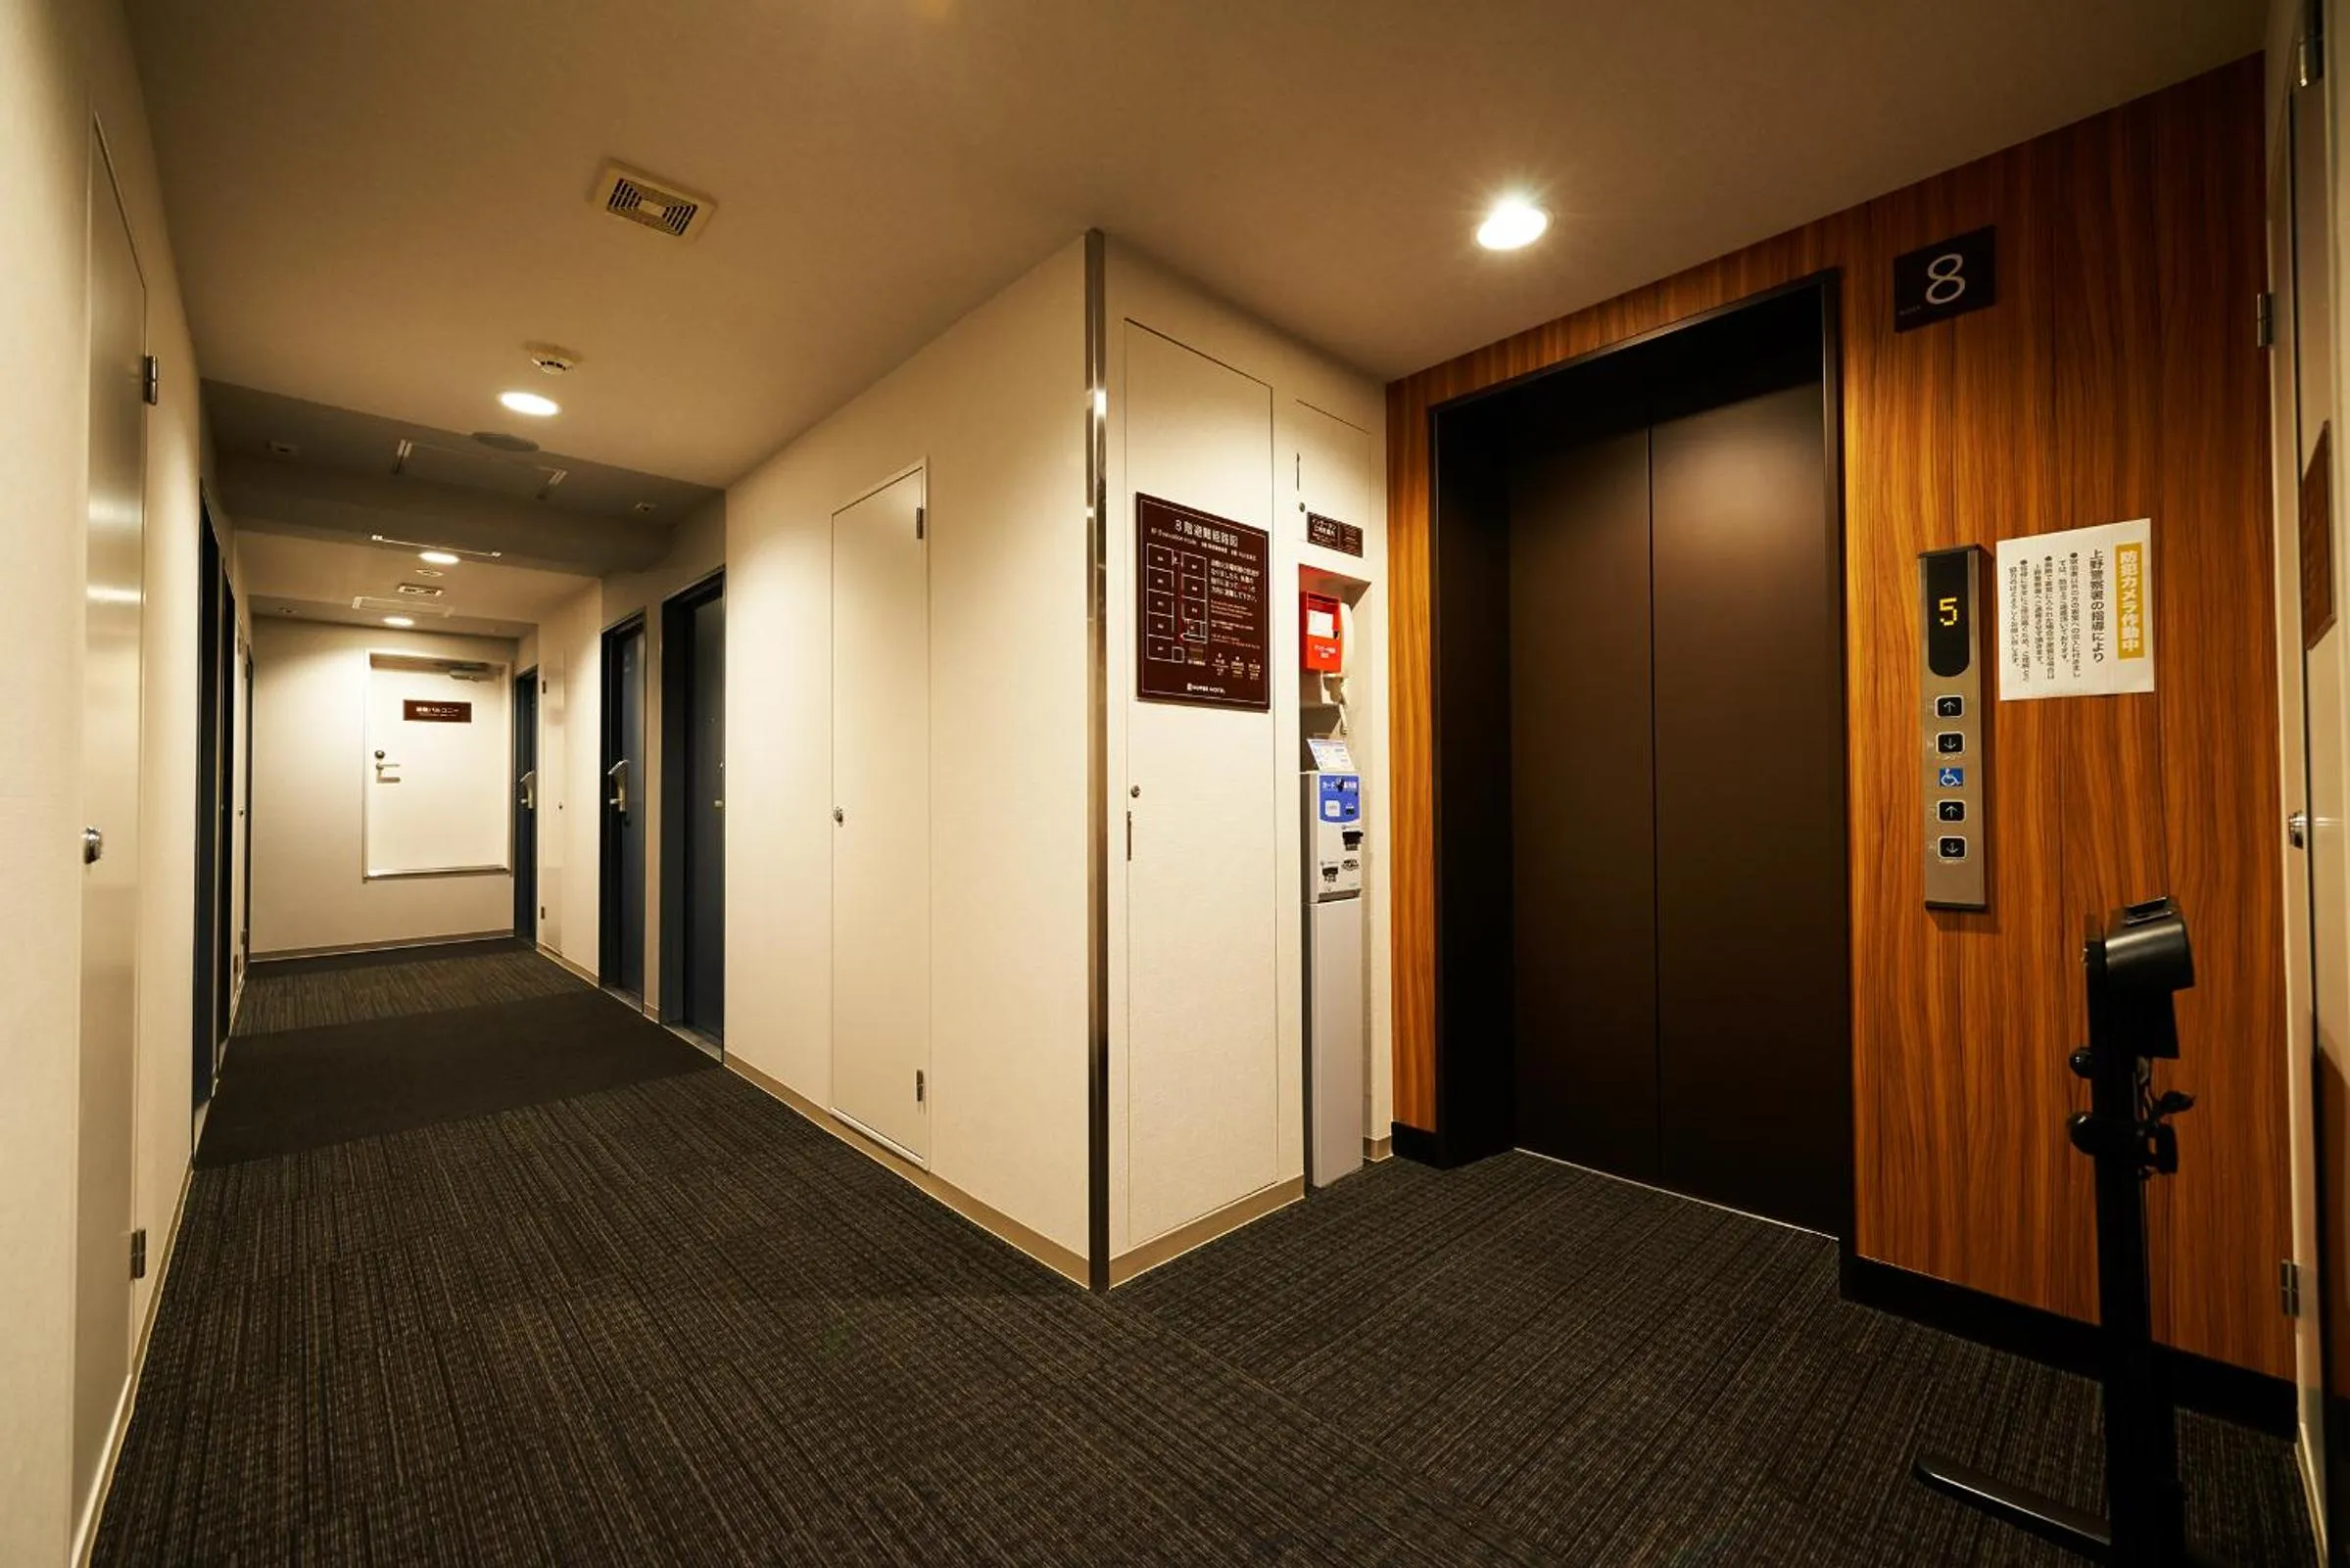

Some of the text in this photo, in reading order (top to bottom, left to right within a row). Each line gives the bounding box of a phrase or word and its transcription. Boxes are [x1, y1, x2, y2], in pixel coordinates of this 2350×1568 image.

[1926, 254, 1965, 305] 8
[1939, 597, 1958, 626] 5
[2090, 548, 2105, 664] 上野警察署の指導により
[2120, 549, 2139, 652] 防犯カメラ作動中
